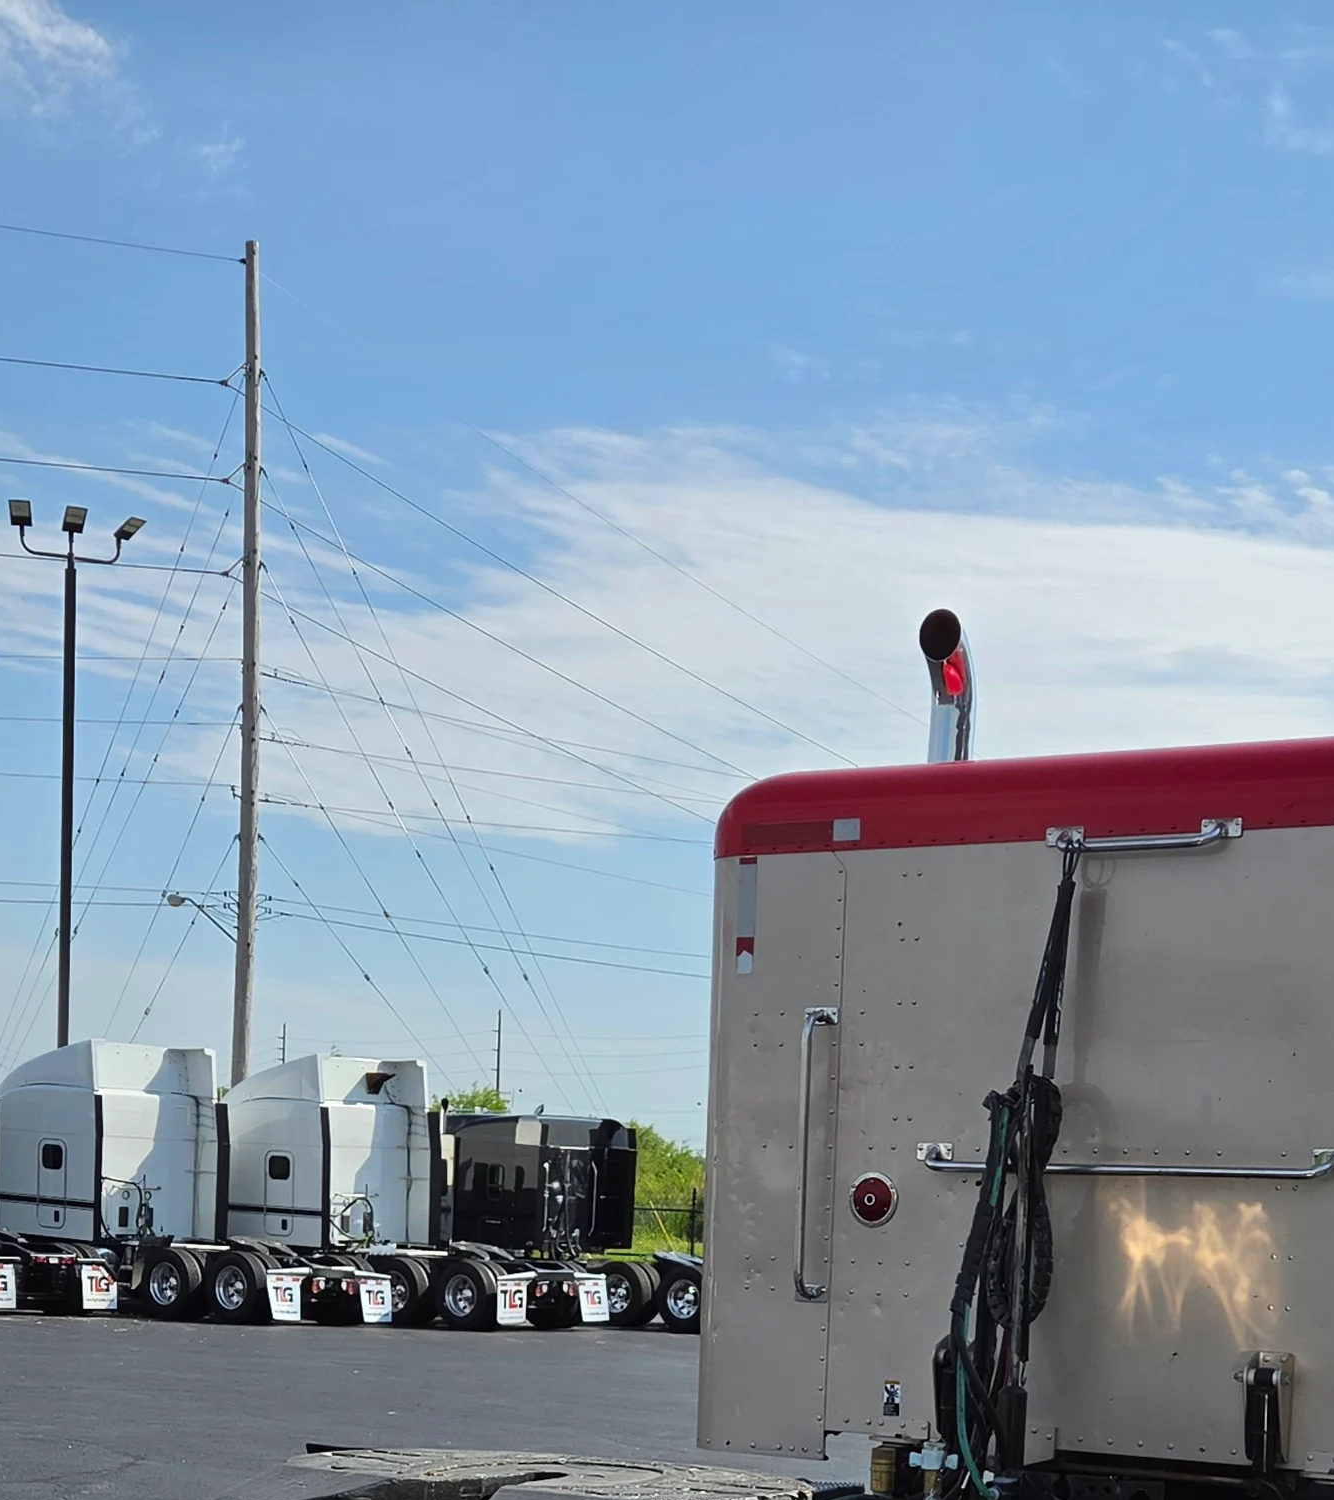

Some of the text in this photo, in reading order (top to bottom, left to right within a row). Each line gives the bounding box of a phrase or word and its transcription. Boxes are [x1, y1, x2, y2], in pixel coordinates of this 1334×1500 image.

[87, 1275, 110, 1292] TLG
[272, 1286, 294, 1302] TLG
[365, 1289, 385, 1305] TLG
[500, 1289, 523, 1309] TLG
[584, 1290, 602, 1305] TLG
